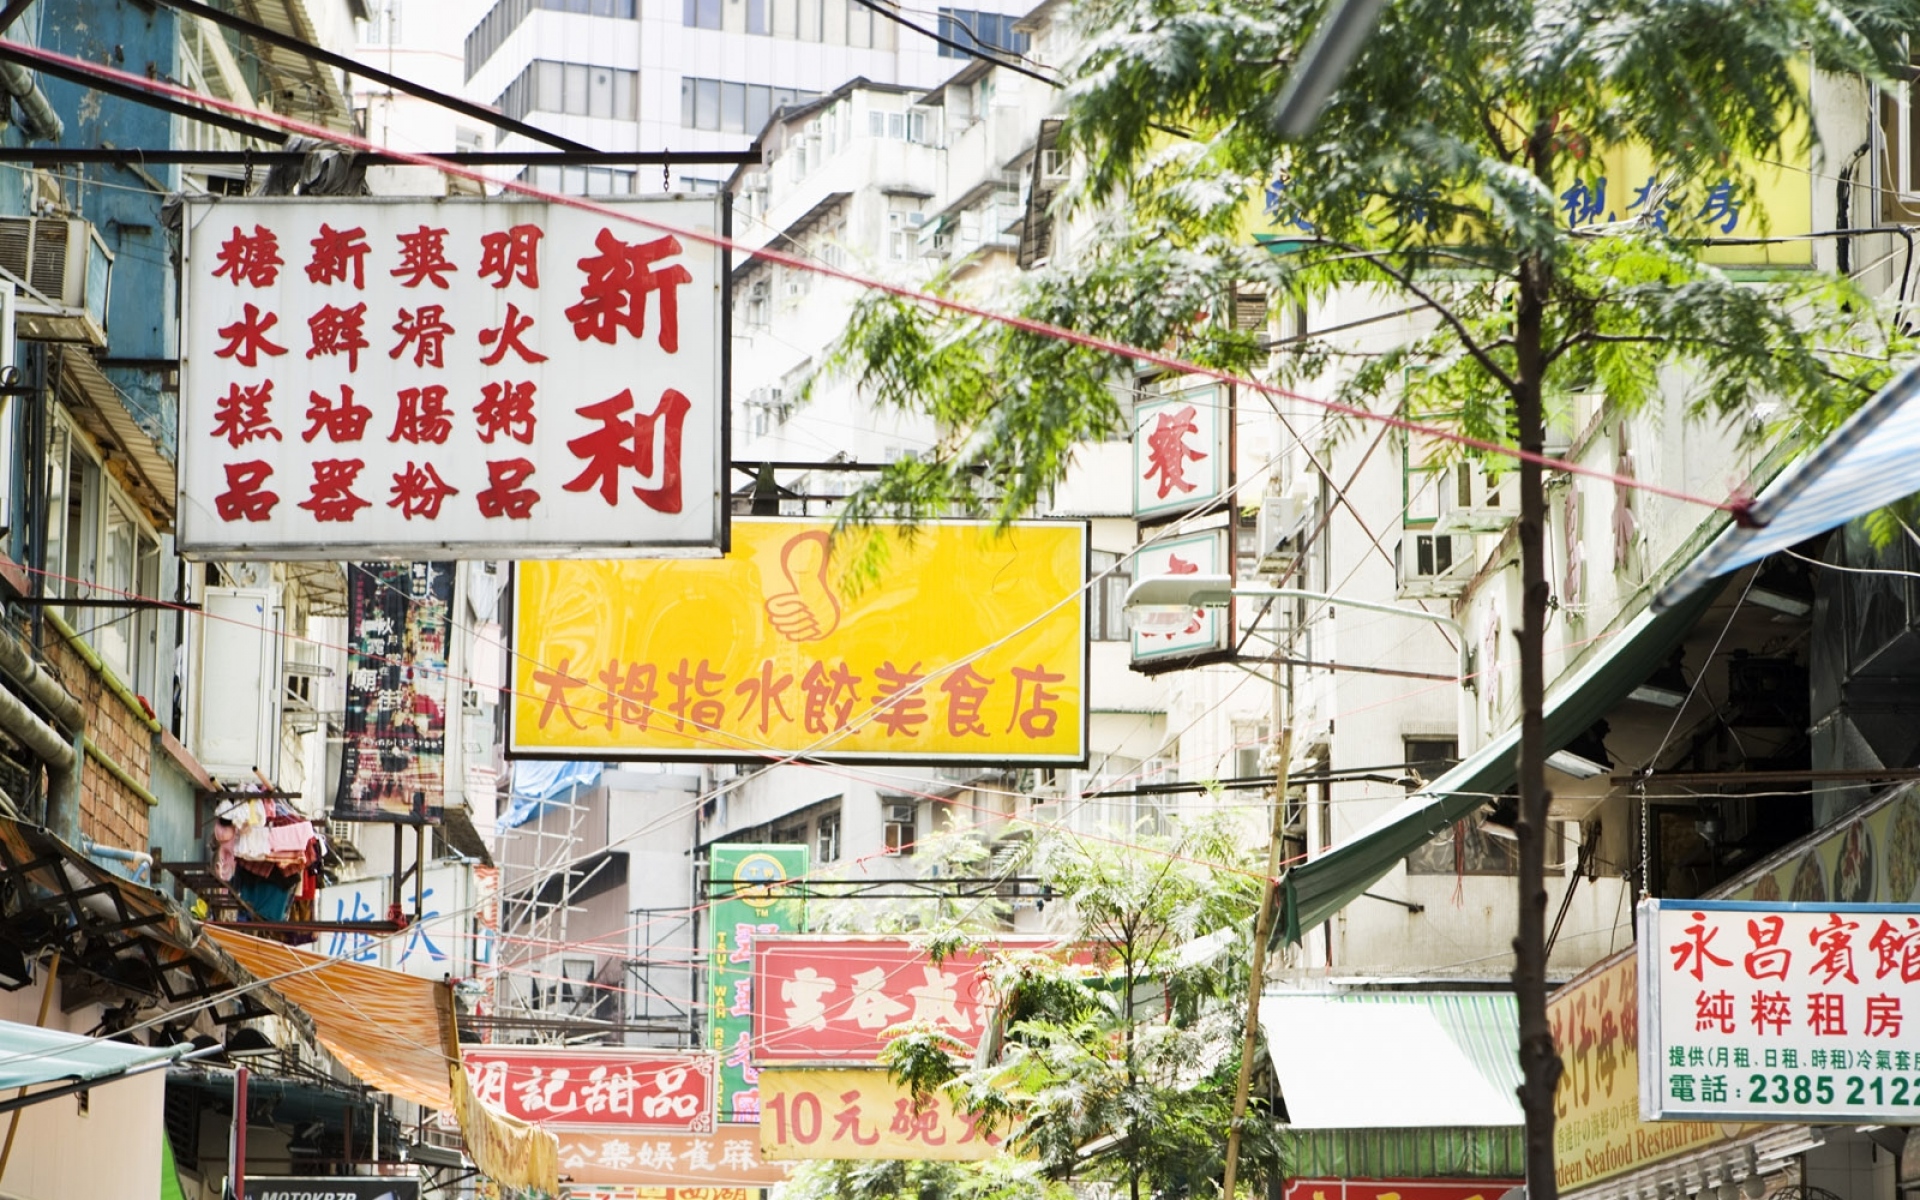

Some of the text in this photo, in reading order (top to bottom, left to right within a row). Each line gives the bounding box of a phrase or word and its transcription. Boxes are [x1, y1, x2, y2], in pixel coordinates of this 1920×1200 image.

[209, 223, 289, 523] 糖水糕品
[297, 223, 373, 523] 新鮮油器
[386, 224, 460, 521] 爽滑腸粉
[472, 223, 550, 520] 明火粥品
[563, 227, 694, 515] 新利
[531, 657, 1067, 740] 大拇指水餃美食店
[1669, 910, 1920, 986] 永昌賓館
[714, 985, 727, 1019] WAH
[1694, 988, 1904, 1039] 純粹租房
[1749, 1074, 1835, 1105] 2385
[1585, 1133, 1634, 1178] Seafood
